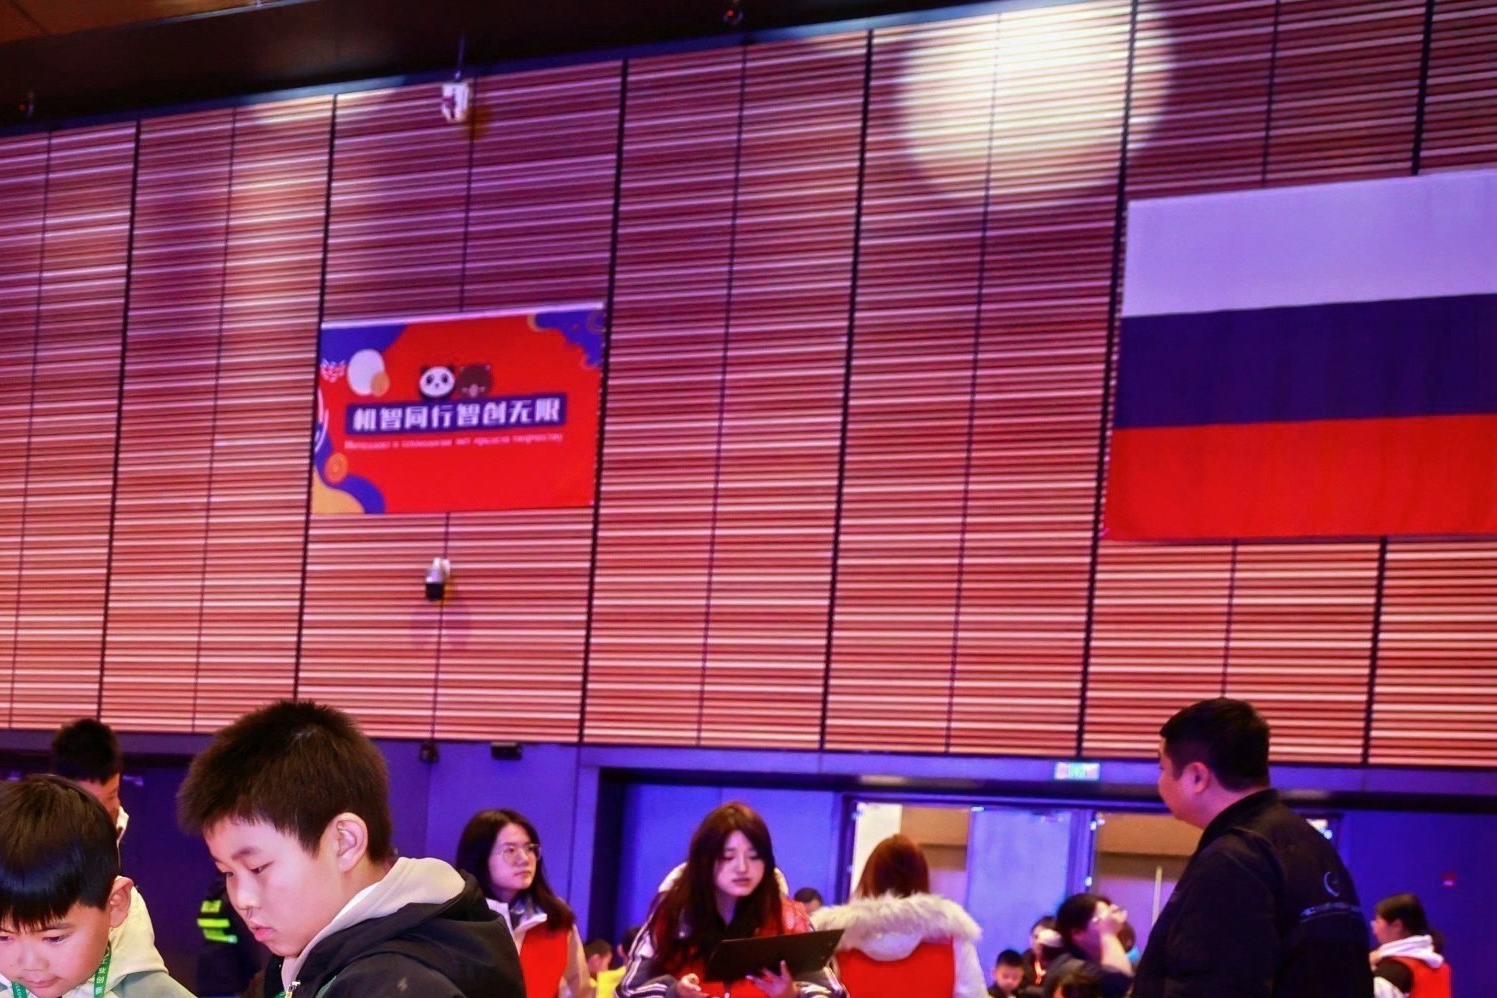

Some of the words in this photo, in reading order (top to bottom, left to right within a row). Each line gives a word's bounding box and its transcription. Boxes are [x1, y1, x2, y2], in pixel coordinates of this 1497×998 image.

[353, 398, 561, 431] 机智同行智创无限
